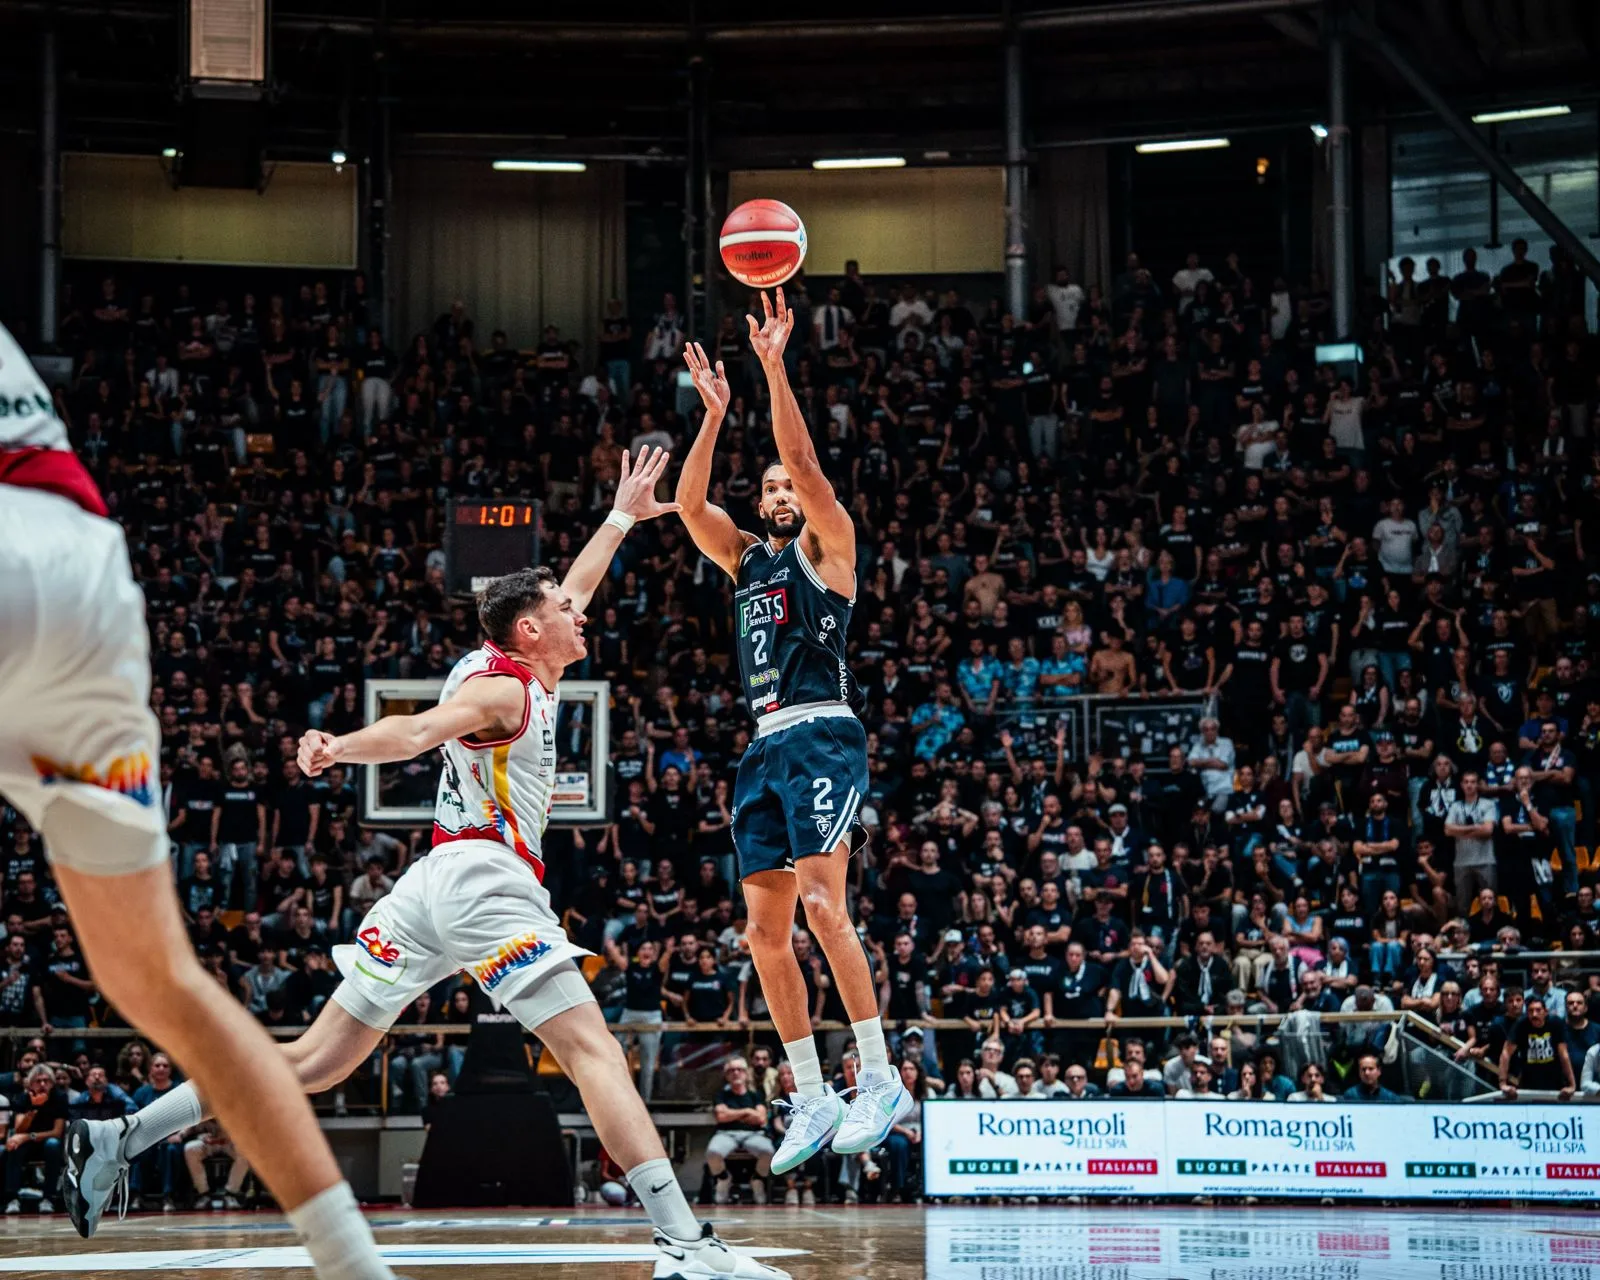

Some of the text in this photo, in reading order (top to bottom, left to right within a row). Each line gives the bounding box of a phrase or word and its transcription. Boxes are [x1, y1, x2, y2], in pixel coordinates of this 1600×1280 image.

[735, 251, 773, 261] molten
[480, 505, 532, 527] 1:01
[749, 615, 772, 626] SERVICE
[751, 629, 768, 666] 2
[812, 777, 834, 811] 2
[978, 1112, 1126, 1145] Romagnoli
[1205, 1113, 1354, 1148] Romagnoli
[1433, 1115, 1584, 1150] Romagnoli
[1105, 1138, 1128, 1149] SPA
[1333, 1140, 1355, 1151] SPA
[1564, 1142, 1587, 1154] SPA
[956, 1162, 1153, 1172] BUONE PATATE ITALIANE
[1184, 1162, 1382, 1174] BUONE PATATE ITALIANE
[1413, 1165, 1469, 1175] BUONE
[1481, 1166, 1541, 1176] PATATE
